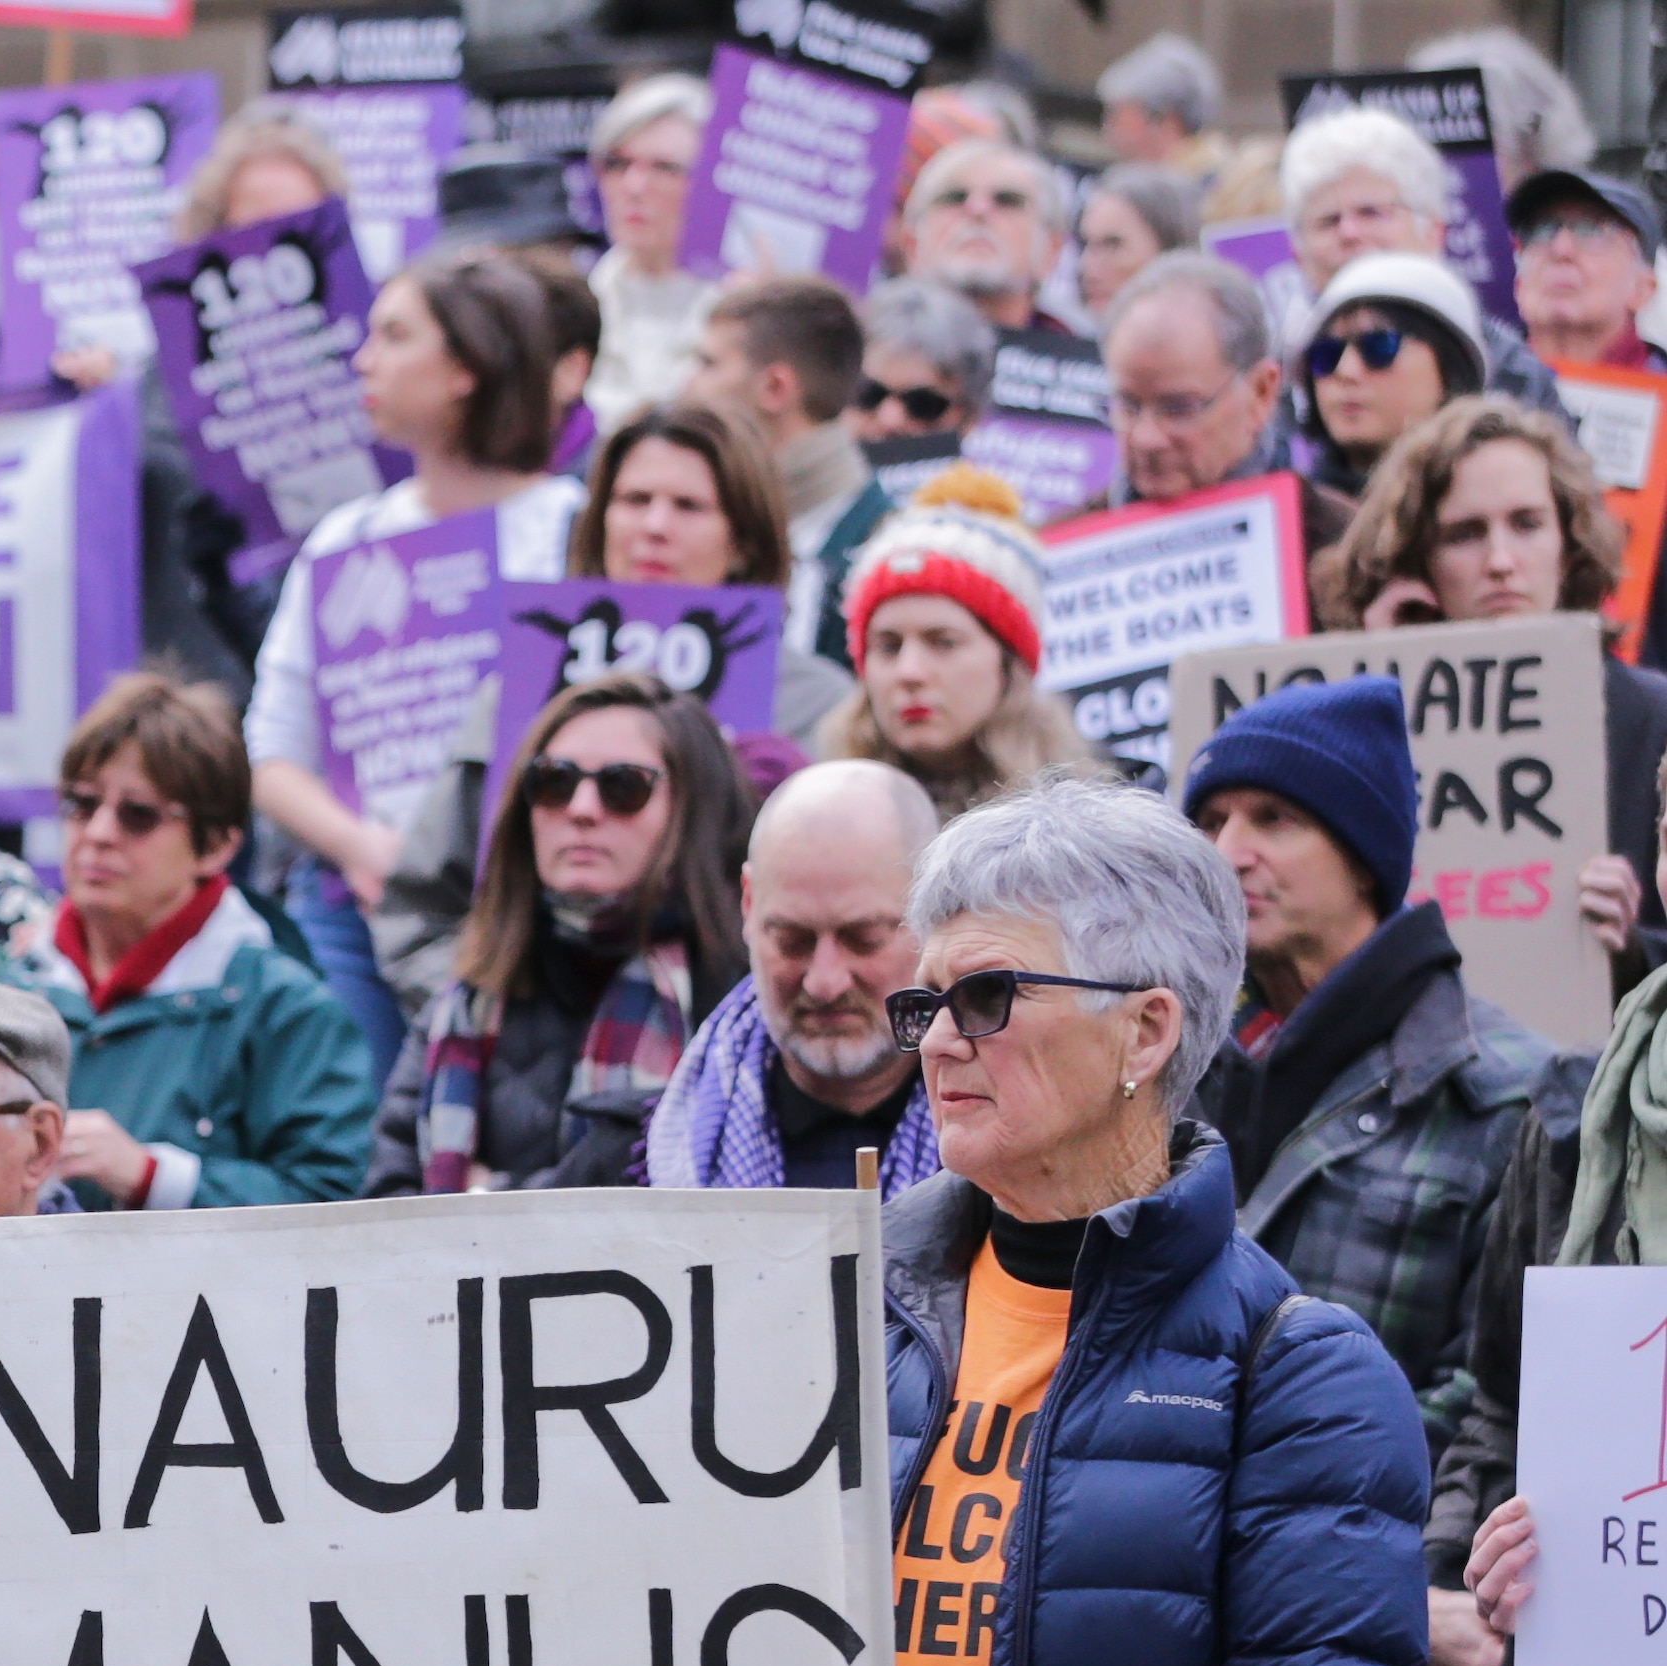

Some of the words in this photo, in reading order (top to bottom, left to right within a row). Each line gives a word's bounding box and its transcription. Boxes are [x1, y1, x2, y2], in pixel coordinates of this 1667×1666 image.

[39, 105, 167, 173] 120
[190, 242, 317, 329] 120
[1047, 556, 1239, 622] WELCOME
[564, 618, 713, 691] 120
[1047, 624, 1113, 666] THE
[1124, 592, 1253, 649] BOATS
[1353, 655, 1543, 736] ATE
[1414, 757, 1565, 839] AR
[1411, 862, 1555, 922] EES
[1152, 1394, 1223, 1412] macpac
